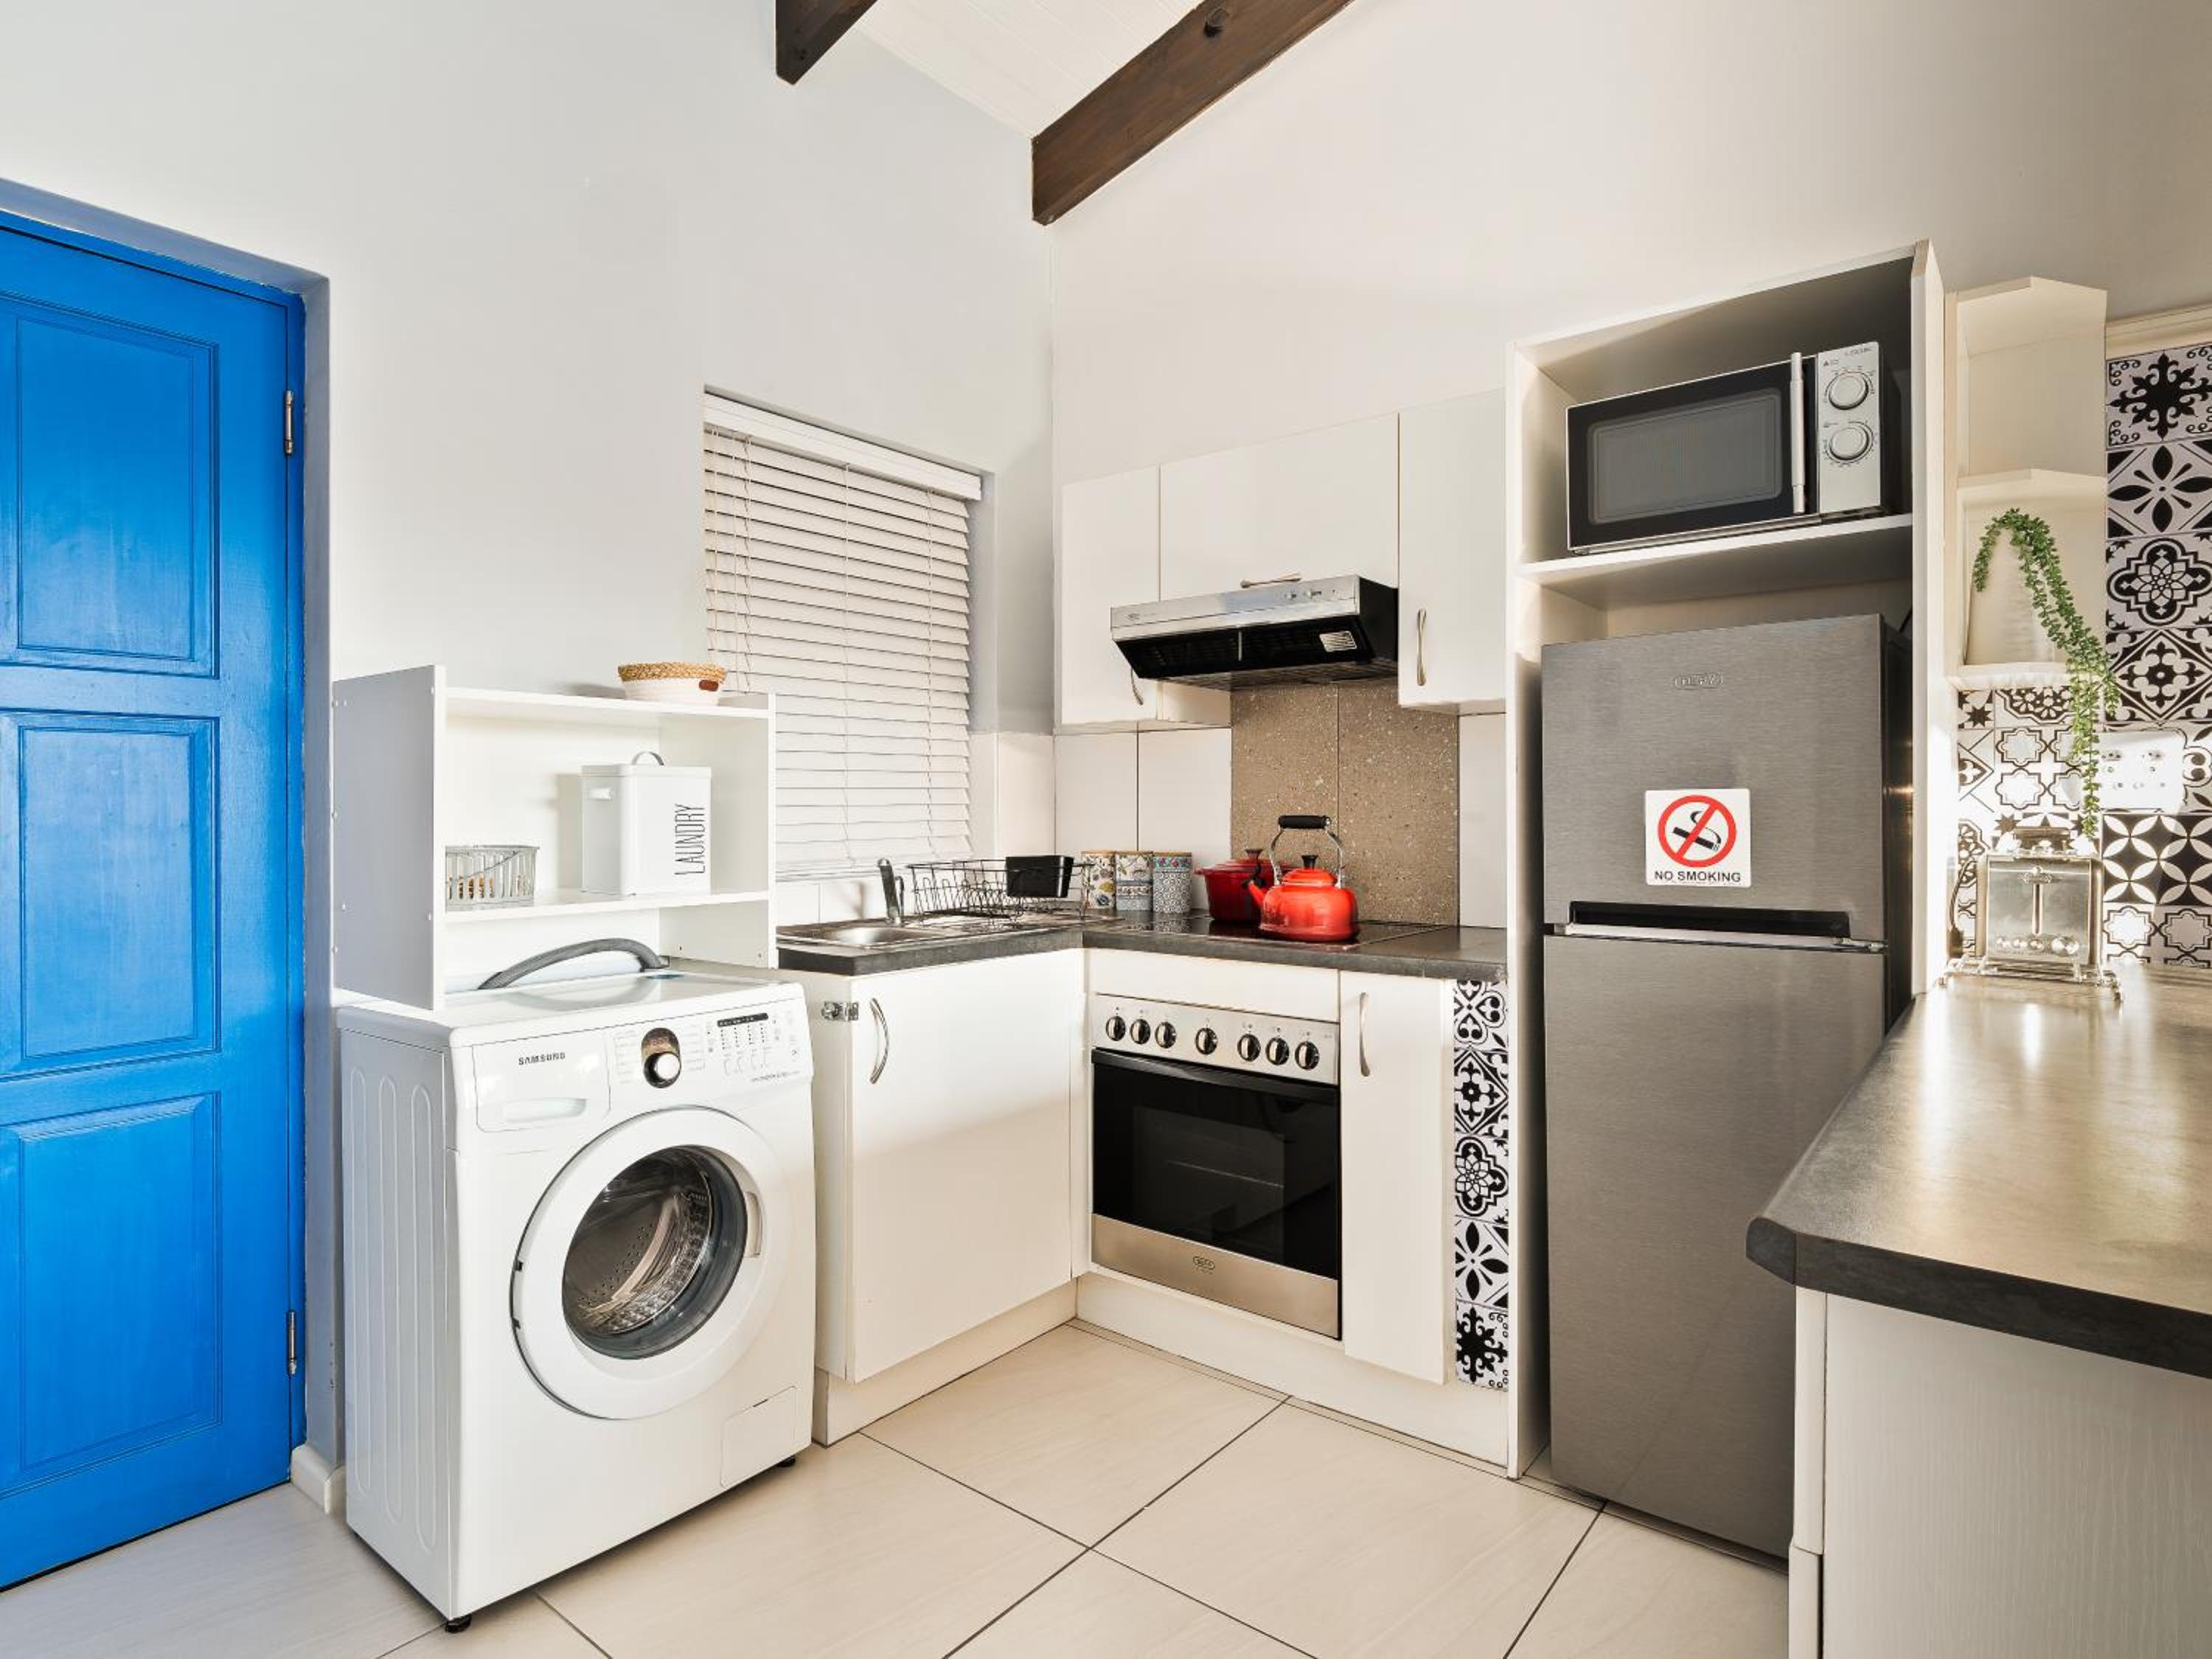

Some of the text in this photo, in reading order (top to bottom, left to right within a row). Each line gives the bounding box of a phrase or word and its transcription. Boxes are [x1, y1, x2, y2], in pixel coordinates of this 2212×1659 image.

[674, 803, 705, 875] LAUNDRY
[1654, 871, 1741, 882] NO SMOKING
[518, 1052, 566, 1065] SAMSUNG
